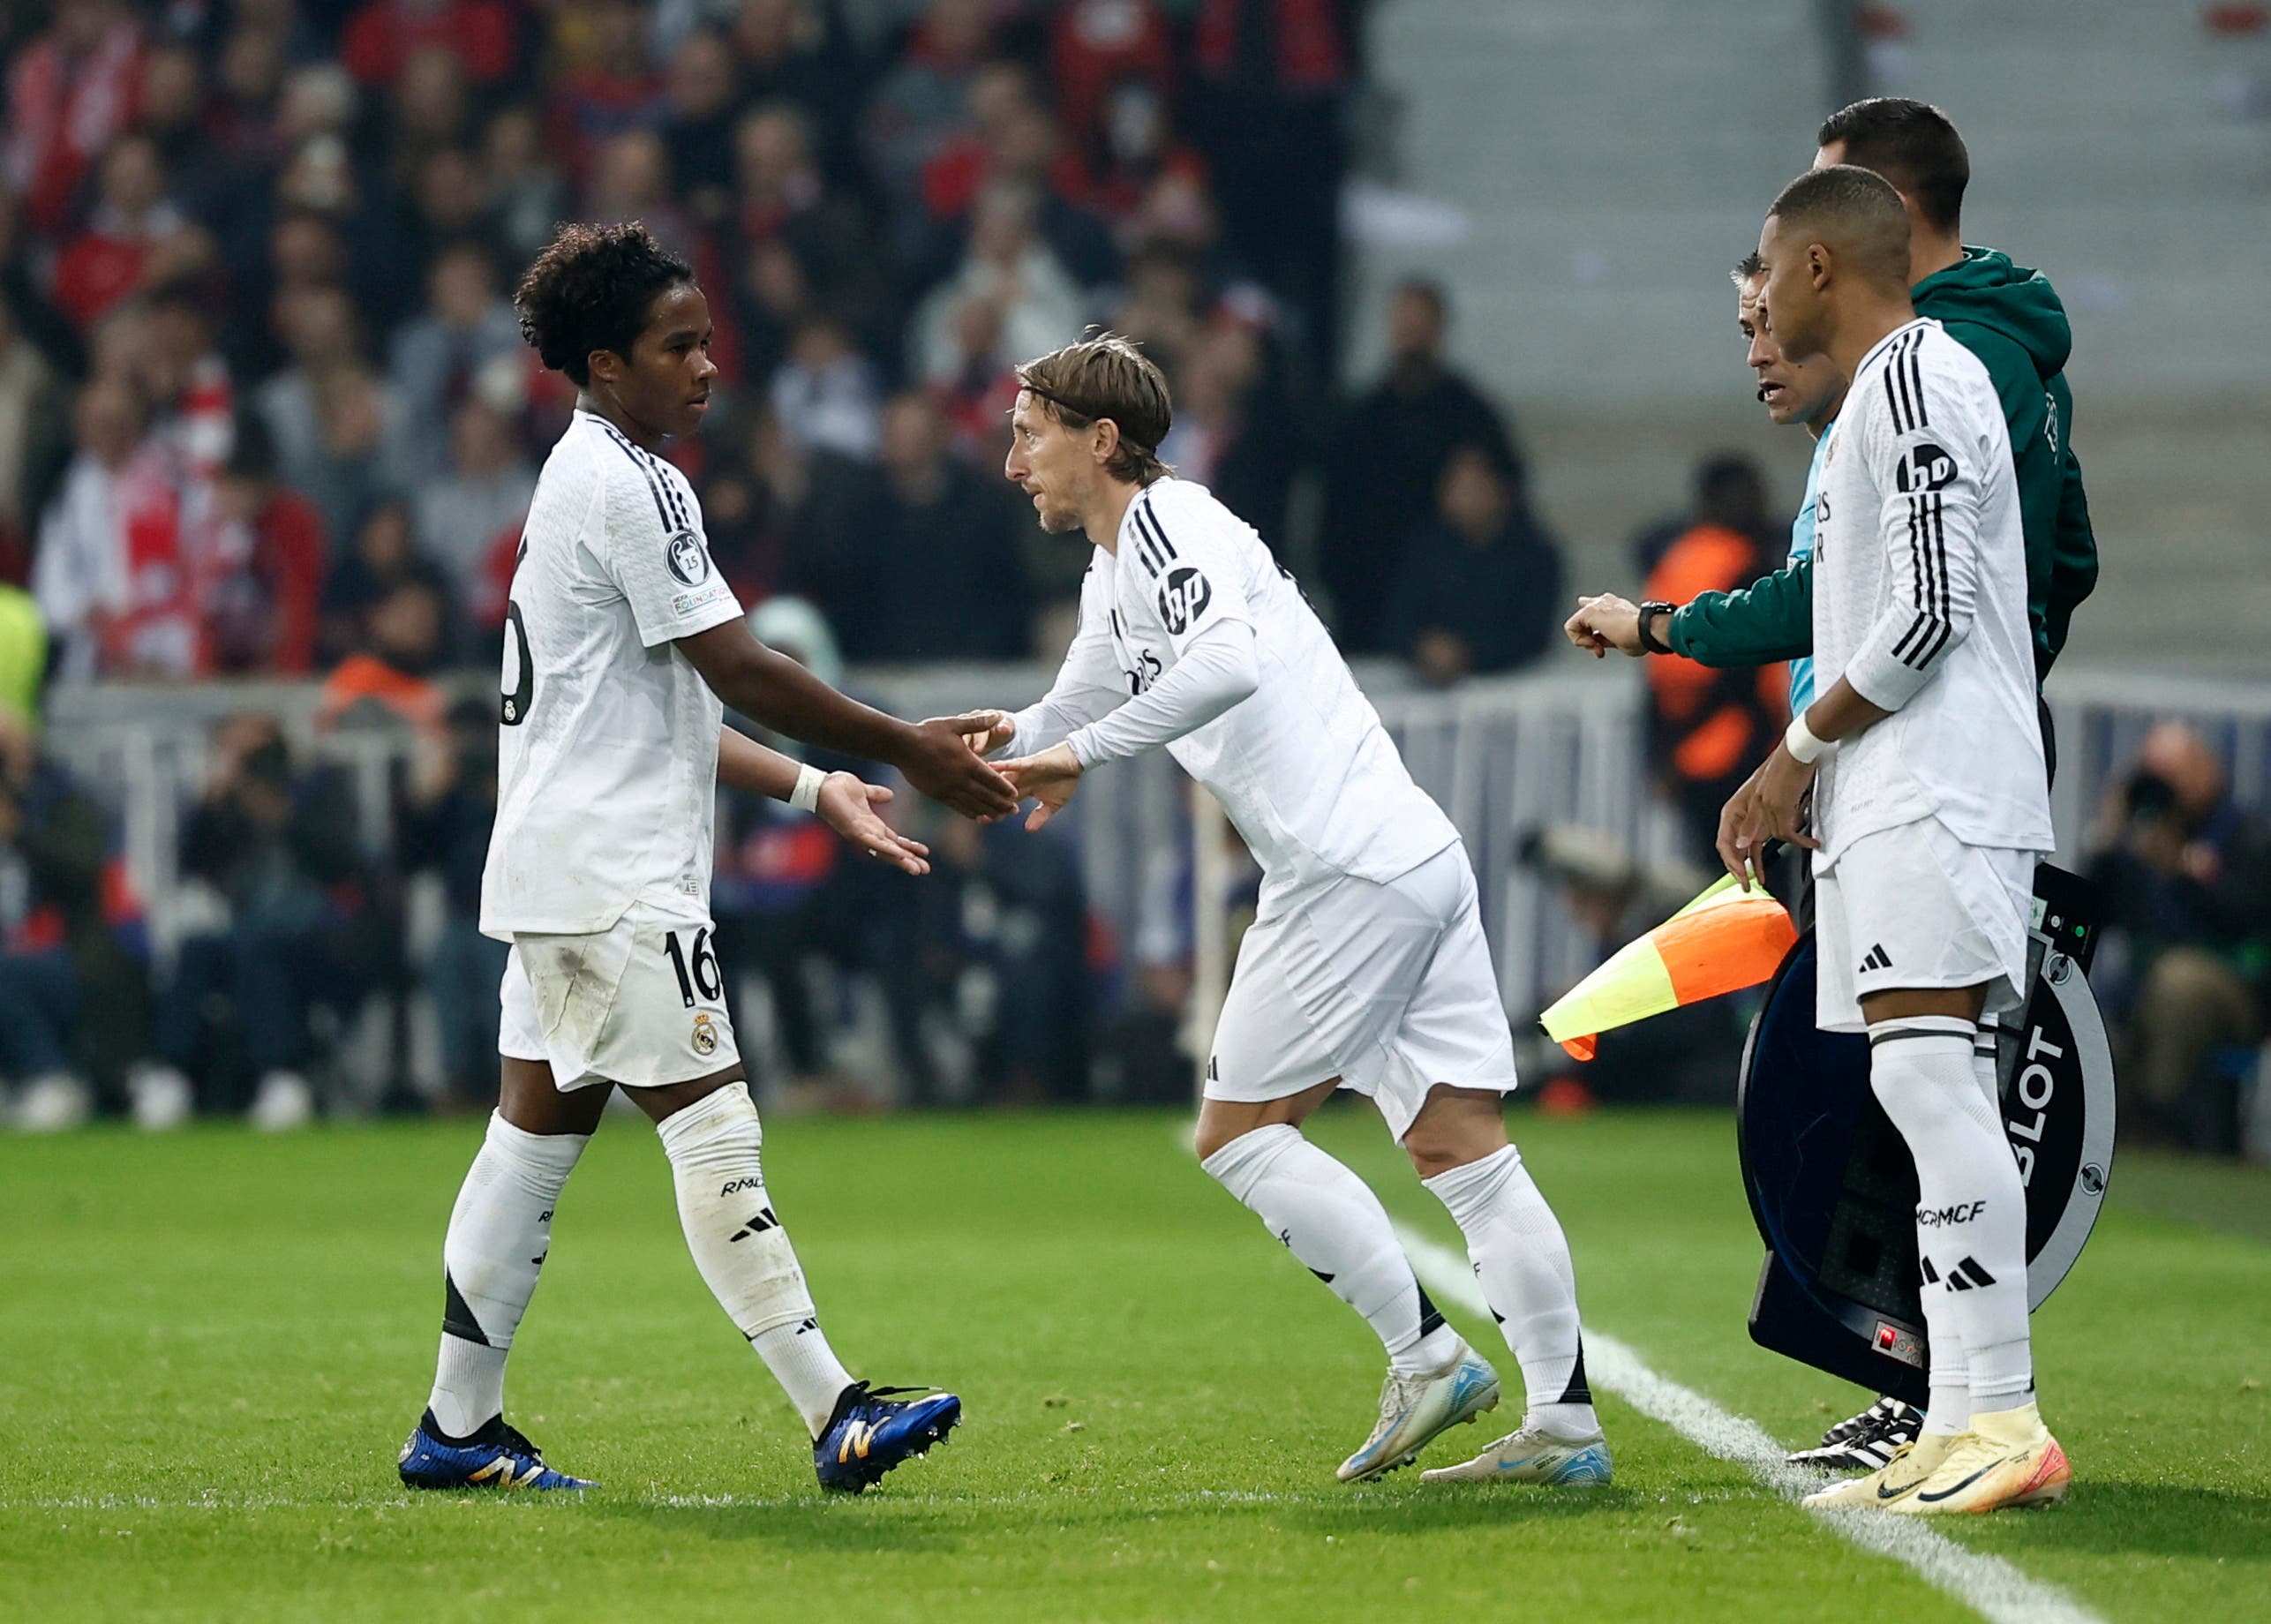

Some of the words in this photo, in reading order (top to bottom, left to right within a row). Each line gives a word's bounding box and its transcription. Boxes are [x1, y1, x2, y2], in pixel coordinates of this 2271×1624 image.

[1897, 444, 1959, 492] hp
[684, 555, 699, 570] 15
[1159, 568, 1212, 635] hp
[665, 927, 720, 1009] 16
